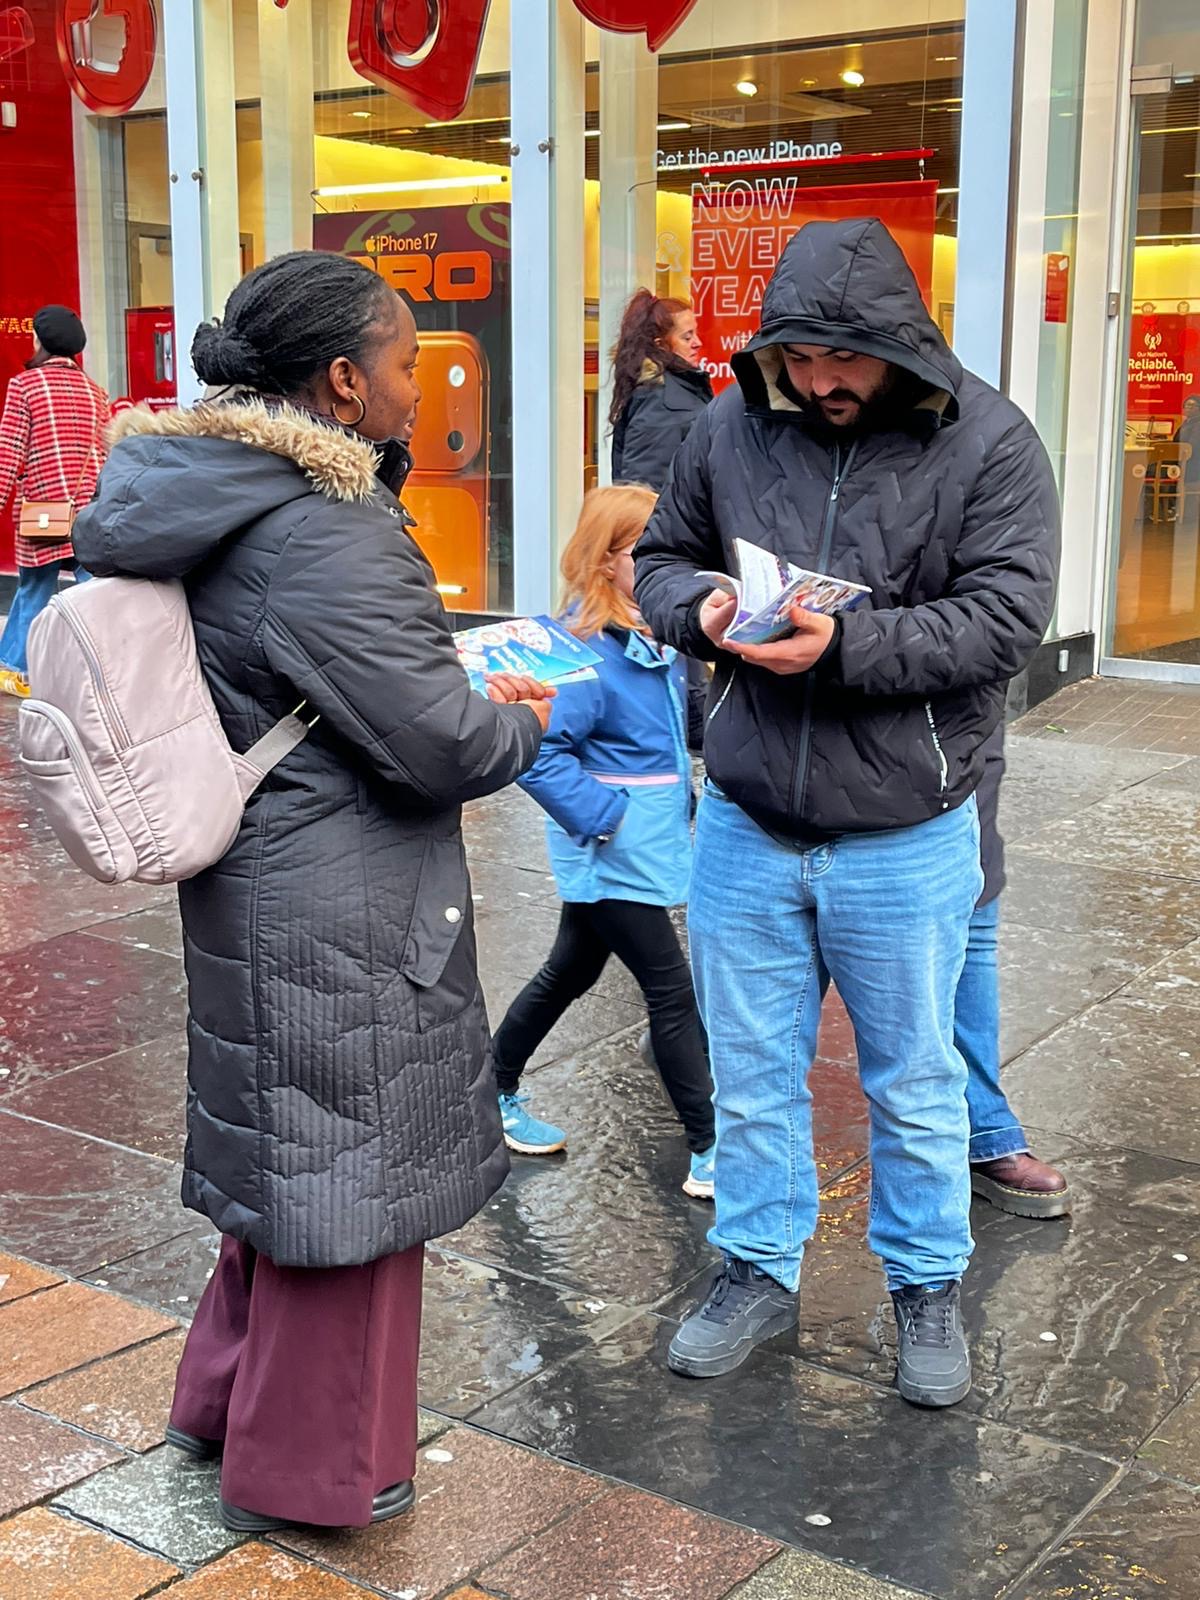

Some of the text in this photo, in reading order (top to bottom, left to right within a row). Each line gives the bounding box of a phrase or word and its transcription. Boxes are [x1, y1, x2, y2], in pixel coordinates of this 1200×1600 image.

[655, 140, 842, 168] Get the new iPhone
[691, 177, 798, 223] NOW
[376, 232, 438, 252] iPhone 17
[1128, 358, 1177, 370] Reliable,
